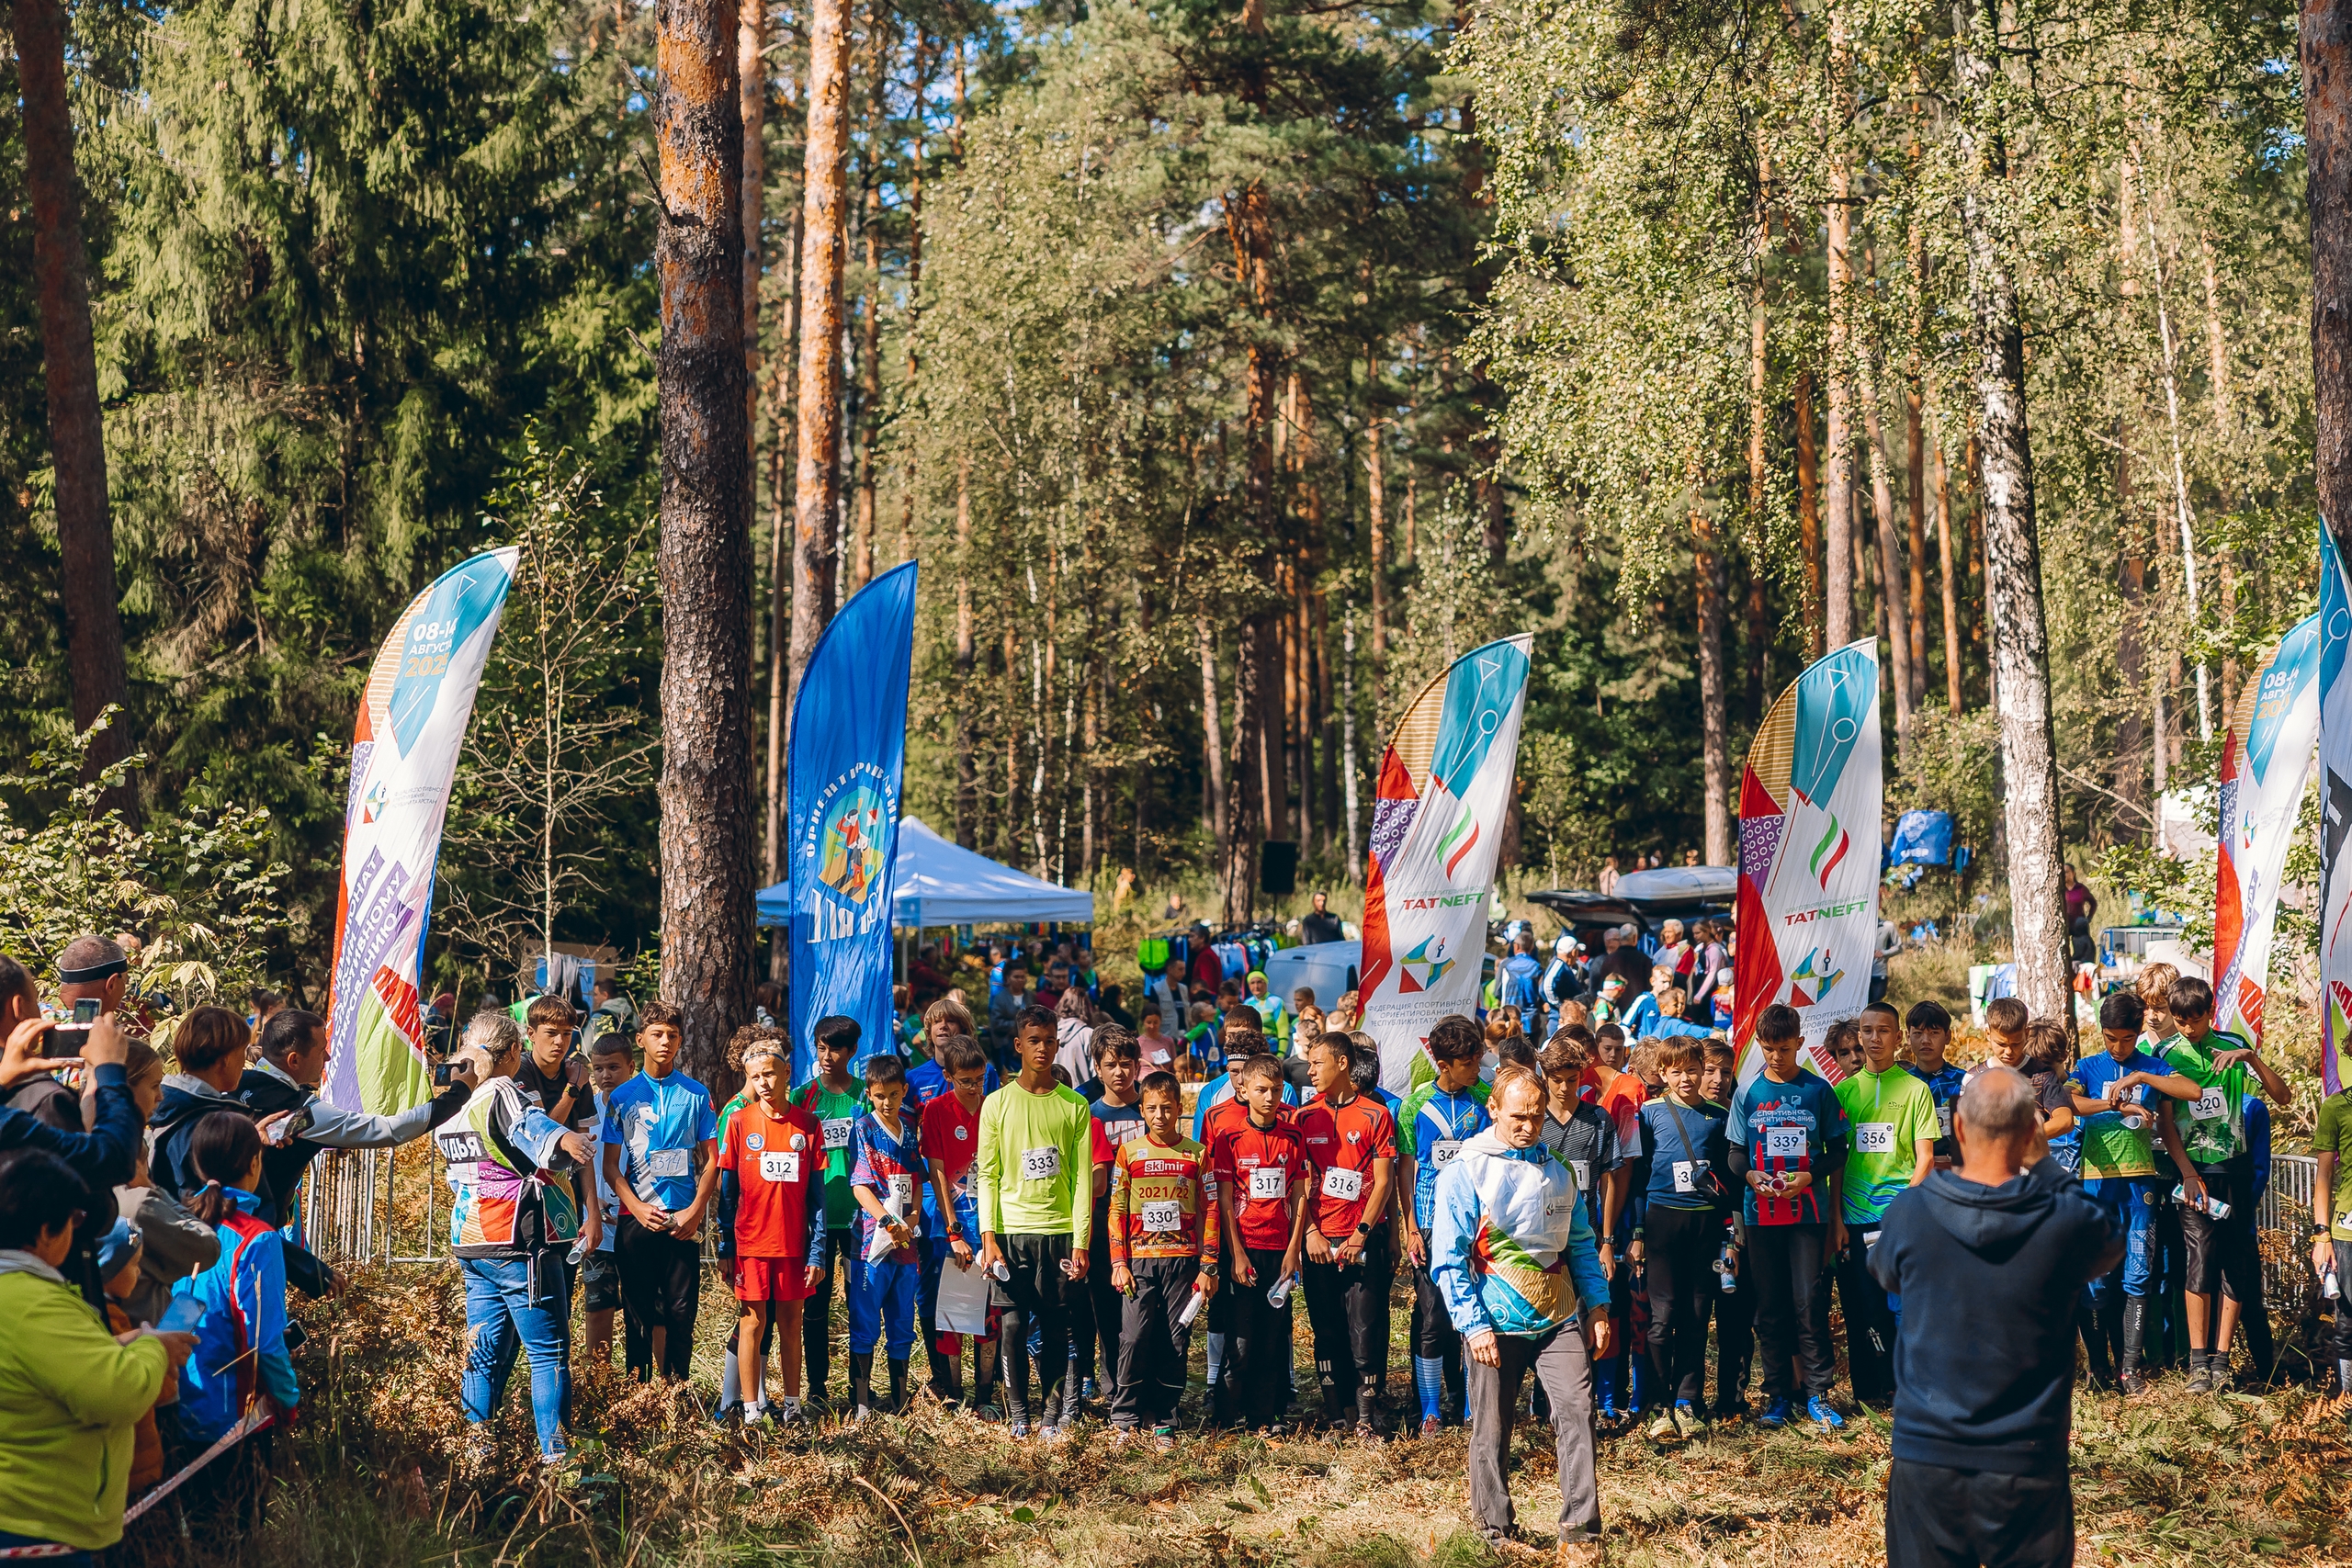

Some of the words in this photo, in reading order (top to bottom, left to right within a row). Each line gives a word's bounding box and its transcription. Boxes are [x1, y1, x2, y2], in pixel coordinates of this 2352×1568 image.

[409, 638, 453, 655] АВГУСТА
[1403, 892, 1485, 910] TATNEFT
[1784, 900, 1869, 926] TATNEFT
[1368, 1002, 1412, 1012] ФЕДЕРАЦИЯ
[1413, 998, 1473, 1009] СПОРТИВНОГО
[1379, 1008, 1453, 1019] ОРИЕНТИРОВАНИЯ
[1804, 1006, 1860, 1022] СПОРТИВНОГО
[2195, 1096, 2221, 1111] 320
[824, 1126, 848, 1140] 338
[1104, 1120, 1146, 1145] WIN
[1861, 1132, 1886, 1145] 356
[1773, 1135, 1799, 1148] 339
[654, 1156, 682, 1172] 314
[766, 1160, 792, 1173] 312
[1028, 1156, 1055, 1171] 333
[1145, 1160, 1185, 1172] skimir
[895, 1183, 911, 1196] 304
[1256, 1178, 1281, 1190] 317
[1329, 1176, 1353, 1192] 316
[1138, 1186, 1189, 1200] 2021/22
[1148, 1210, 1172, 1224] 330
